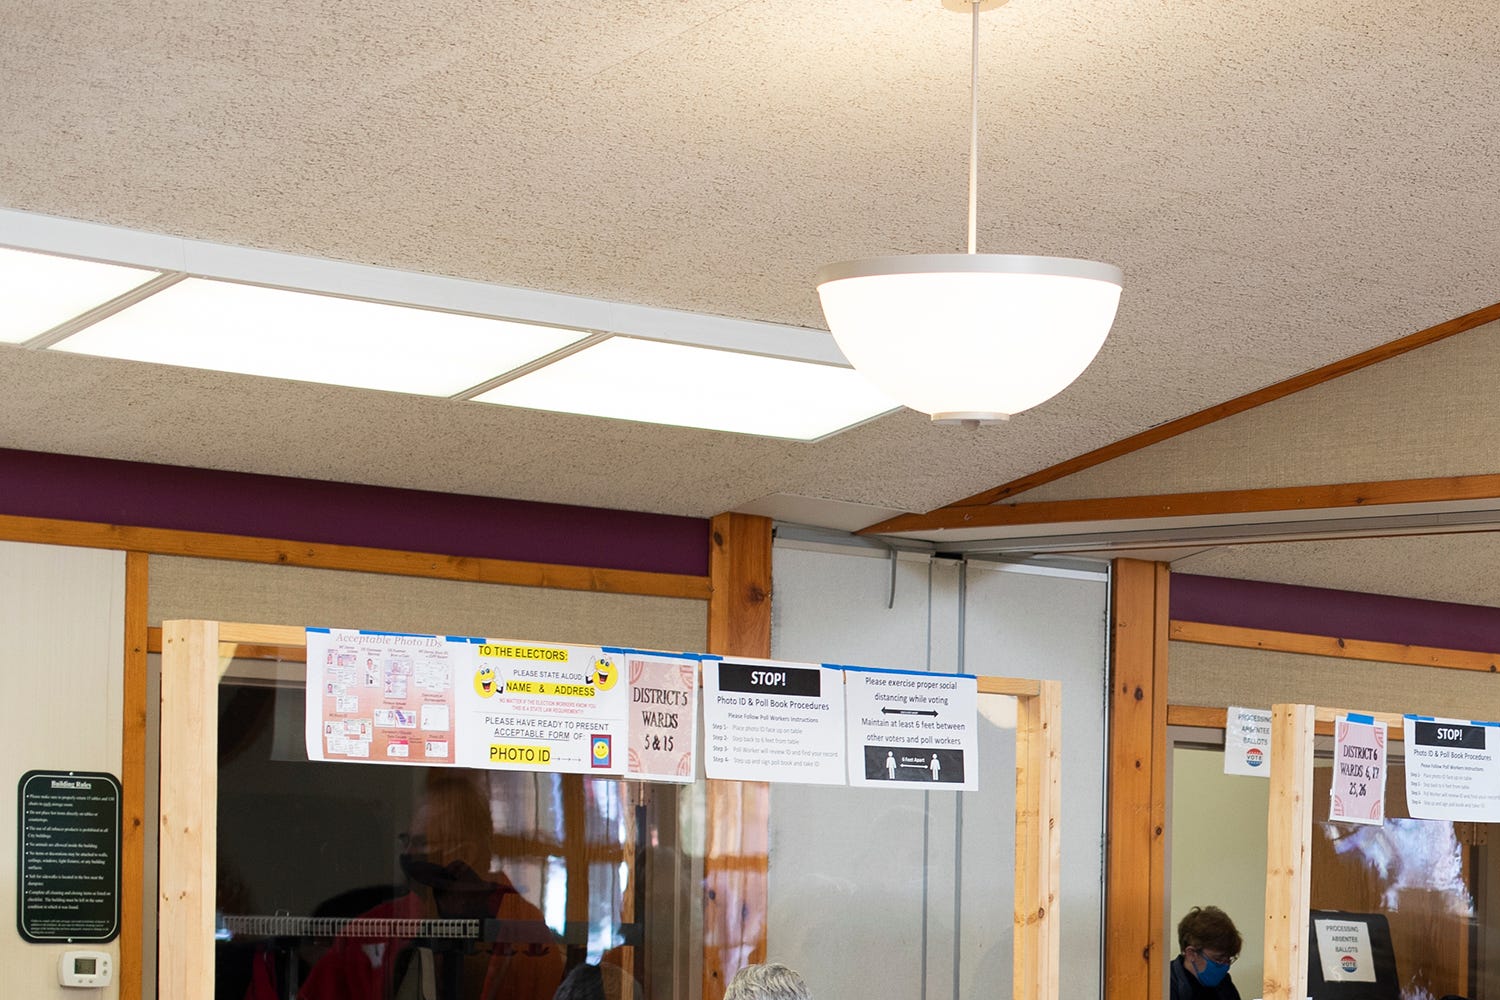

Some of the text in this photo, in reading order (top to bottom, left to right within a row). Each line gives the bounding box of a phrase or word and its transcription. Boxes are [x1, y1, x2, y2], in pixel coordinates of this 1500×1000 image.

[336, 633, 442, 647] Acceptable Photo IDs
[479, 646, 568, 660] TO THE ELECTORS:
[751, 671, 786, 686] STOP!
[865, 677, 886, 686] Please
[888, 679, 915, 687] exercise
[917, 680, 938, 690] proper
[506, 682, 595, 696] NAME & ADDRESS
[633, 687, 688, 706] DISTRICT 5
[717, 696, 737, 705] Photo
[749, 698, 753, 706] &
[756, 699, 768, 707] Poll
[771, 700, 788, 708] Book
[790, 701, 829, 710] Procedures
[875, 693, 949, 705] distancing while voting
[485, 717, 514, 725] PLEASE
[517, 718, 535, 726] HAVE
[538, 720, 562, 729] READY
[576, 722, 608, 731] PRESENT
[642, 711, 678, 728] WARDS
[862, 718, 889, 727] Maintain
[899, 720, 914, 728] least
[922, 721, 935, 729] feet
[936, 722, 965, 730] between
[494, 728, 544, 738] ACCEPTABLE
[885, 735, 905, 743] voters
[921, 736, 933, 744] poll
[935, 737, 961, 745] workers
[1437, 728, 1462, 740] STOP!
[645, 734, 673, 751] 5 & 15
[490, 747, 550, 762] PHOTO ID
[1343, 745, 1377, 760] DISTRICT 6
[1340, 762, 1363, 777] WARDS
[76, 781, 92, 789] Rules
